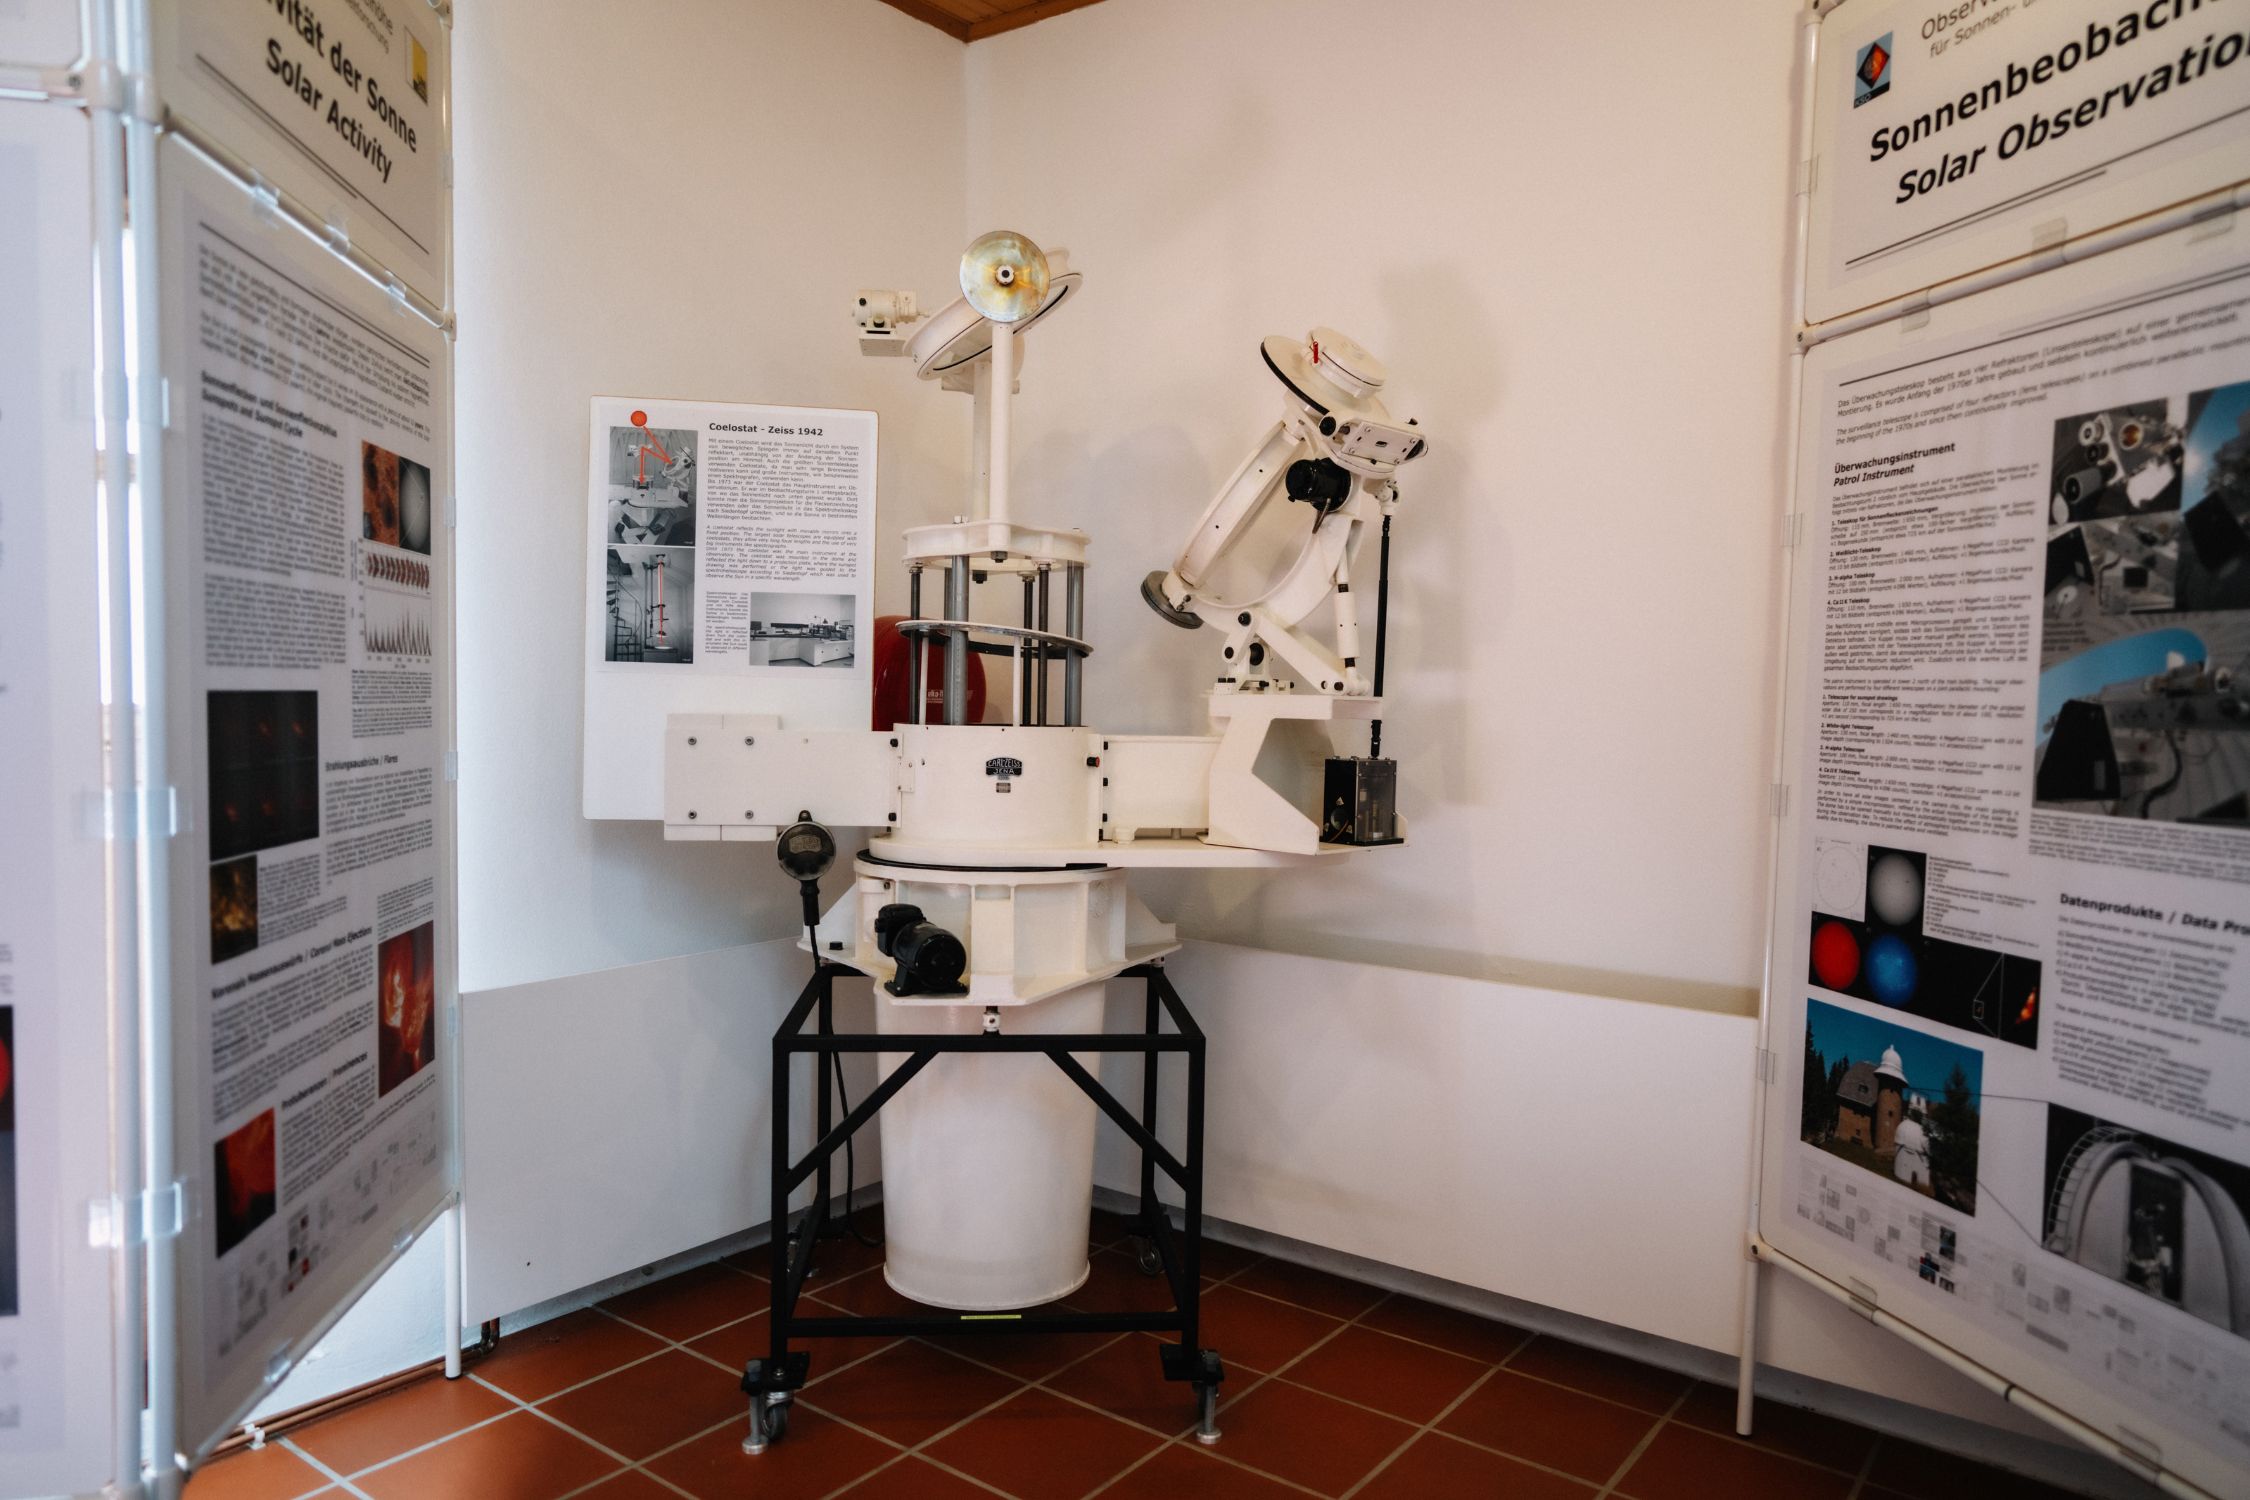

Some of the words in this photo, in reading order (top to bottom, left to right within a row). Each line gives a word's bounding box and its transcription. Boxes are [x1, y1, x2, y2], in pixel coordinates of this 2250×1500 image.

[266, 38, 323, 111] Solar
[327, 99, 392, 183] Activity
[330, 41, 361, 94] der
[367, 78, 416, 153] Sonne
[1896, 146, 1986, 204] Solar
[1998, 33, 2250, 160] Observatio
[709, 422, 758, 433] Coelostat
[768, 426, 795, 434] Zeiss
[799, 427, 823, 436] 1942
[1834, 443, 1955, 474] Überwachungsinstrument
[1834, 474, 1860, 487] Patrol
[1862, 464, 1915, 482] Instrument
[988, 758, 1004, 768] CARL
[1004, 758, 1021, 768] ZEISS
[2060, 893, 2163, 920] Datenprodukte
[2182, 914, 2218, 930] Data
